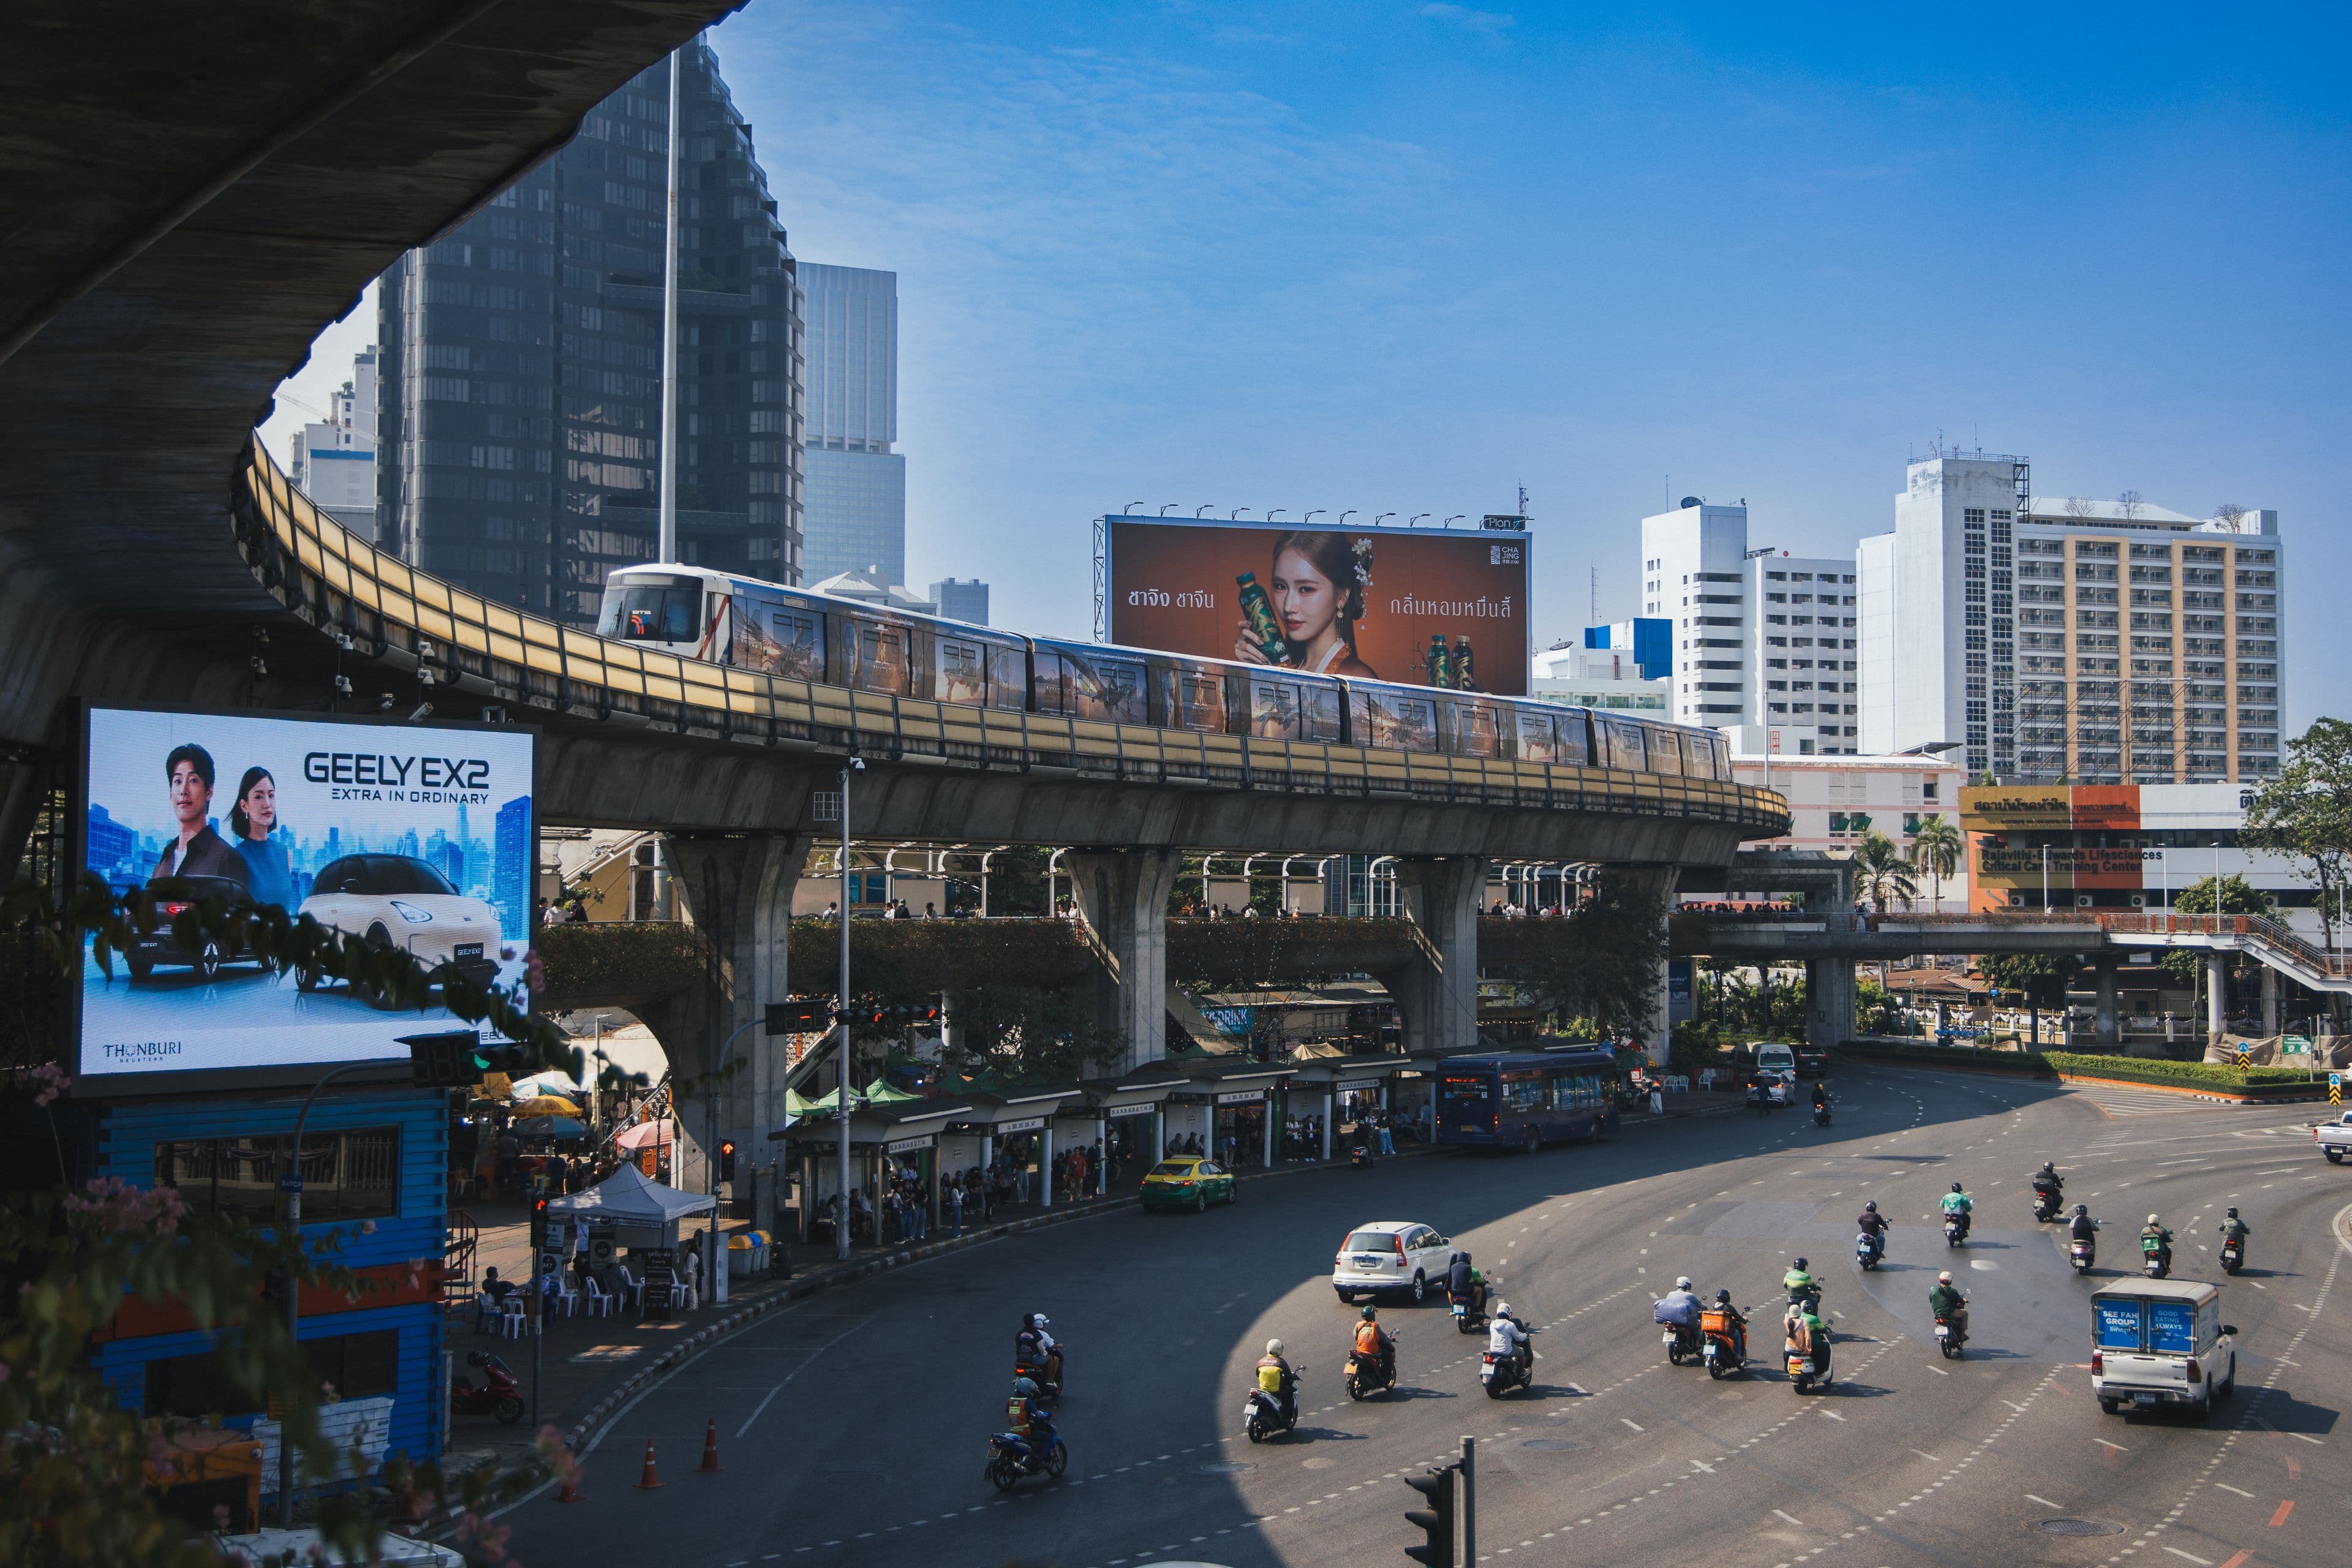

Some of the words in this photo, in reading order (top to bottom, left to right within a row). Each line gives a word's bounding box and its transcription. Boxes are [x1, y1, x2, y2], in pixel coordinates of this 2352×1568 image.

[1489, 518, 1510, 527] Plan
[1128, 589, 1170, 607] ชาจิง
[1177, 590, 1214, 608] ชาจีน
[1391, 593, 1511, 617] กลิ่นหอมหมื่นลี้
[304, 752, 416, 786] GEELY
[421, 757, 489, 790] EX2
[331, 788, 382, 801] EXTRA
[389, 790, 404, 801] IN
[410, 791, 489, 805] ORDINARY
[2089, 850, 2162, 861] Lifesciences
[2052, 860, 2098, 873] Training
[2103, 860, 2142, 871] Center
